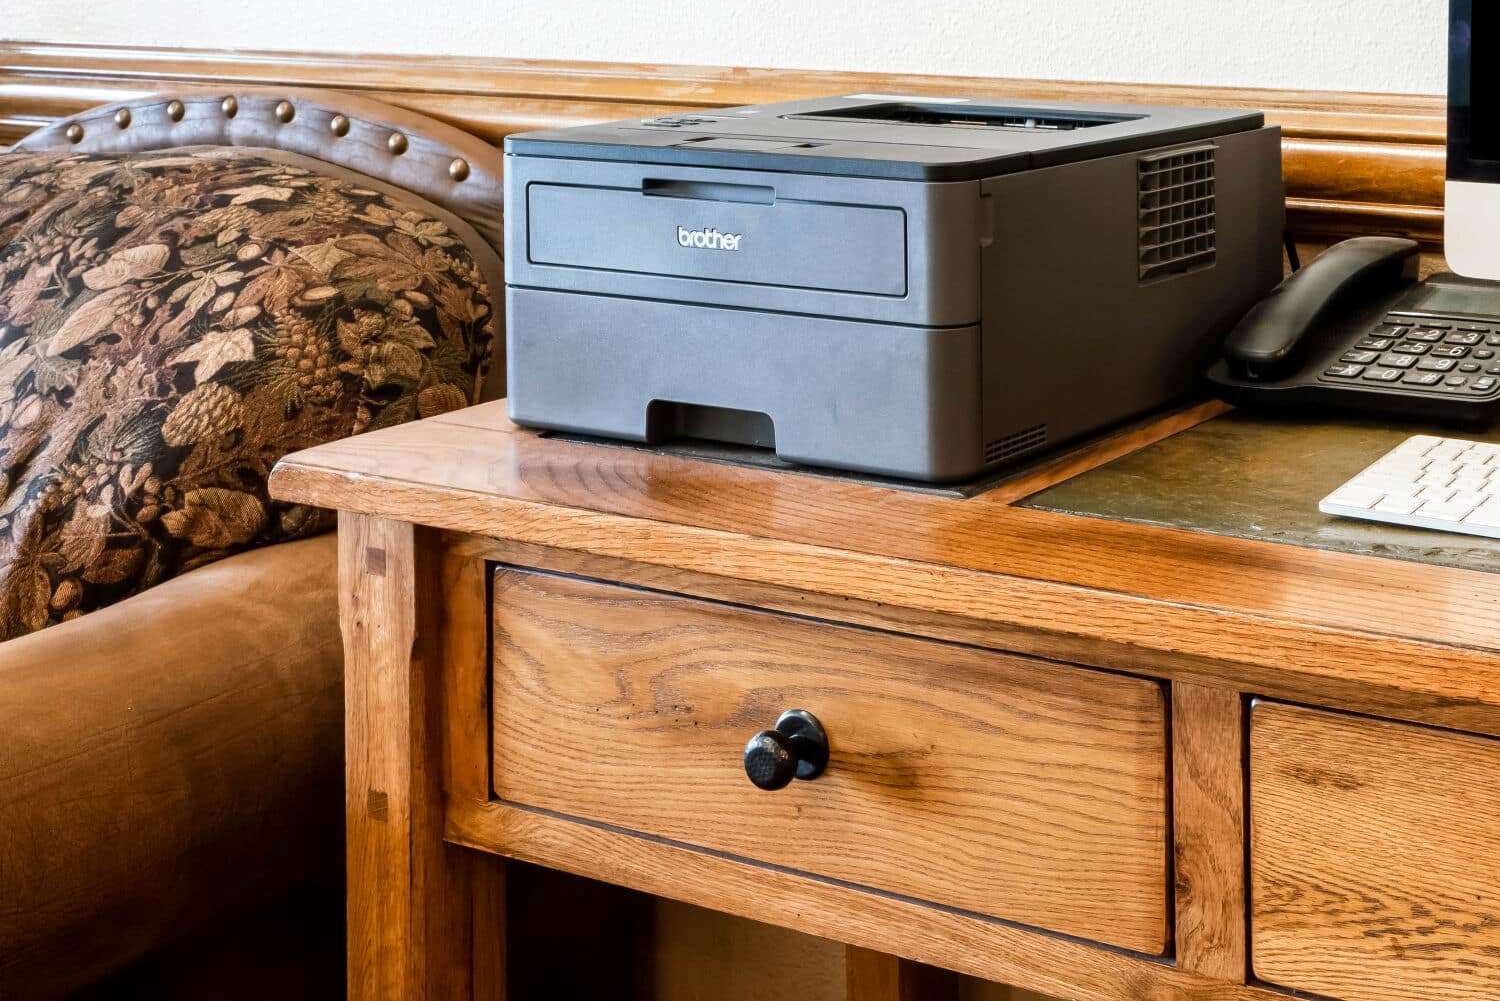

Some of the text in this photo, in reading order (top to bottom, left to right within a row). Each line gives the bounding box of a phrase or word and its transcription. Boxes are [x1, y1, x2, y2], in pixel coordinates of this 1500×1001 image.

[677, 226, 742, 251] brother
[1424, 330, 1440, 340] 2
[1462, 333, 1479, 343] 3
[1372, 339, 1387, 349] 4
[1411, 343, 1428, 352] 5
[1449, 346, 1466, 356] 6
[1396, 355, 1412, 365] 8
[1435, 359, 1451, 369] 9
[1382, 369, 1397, 379] 0
